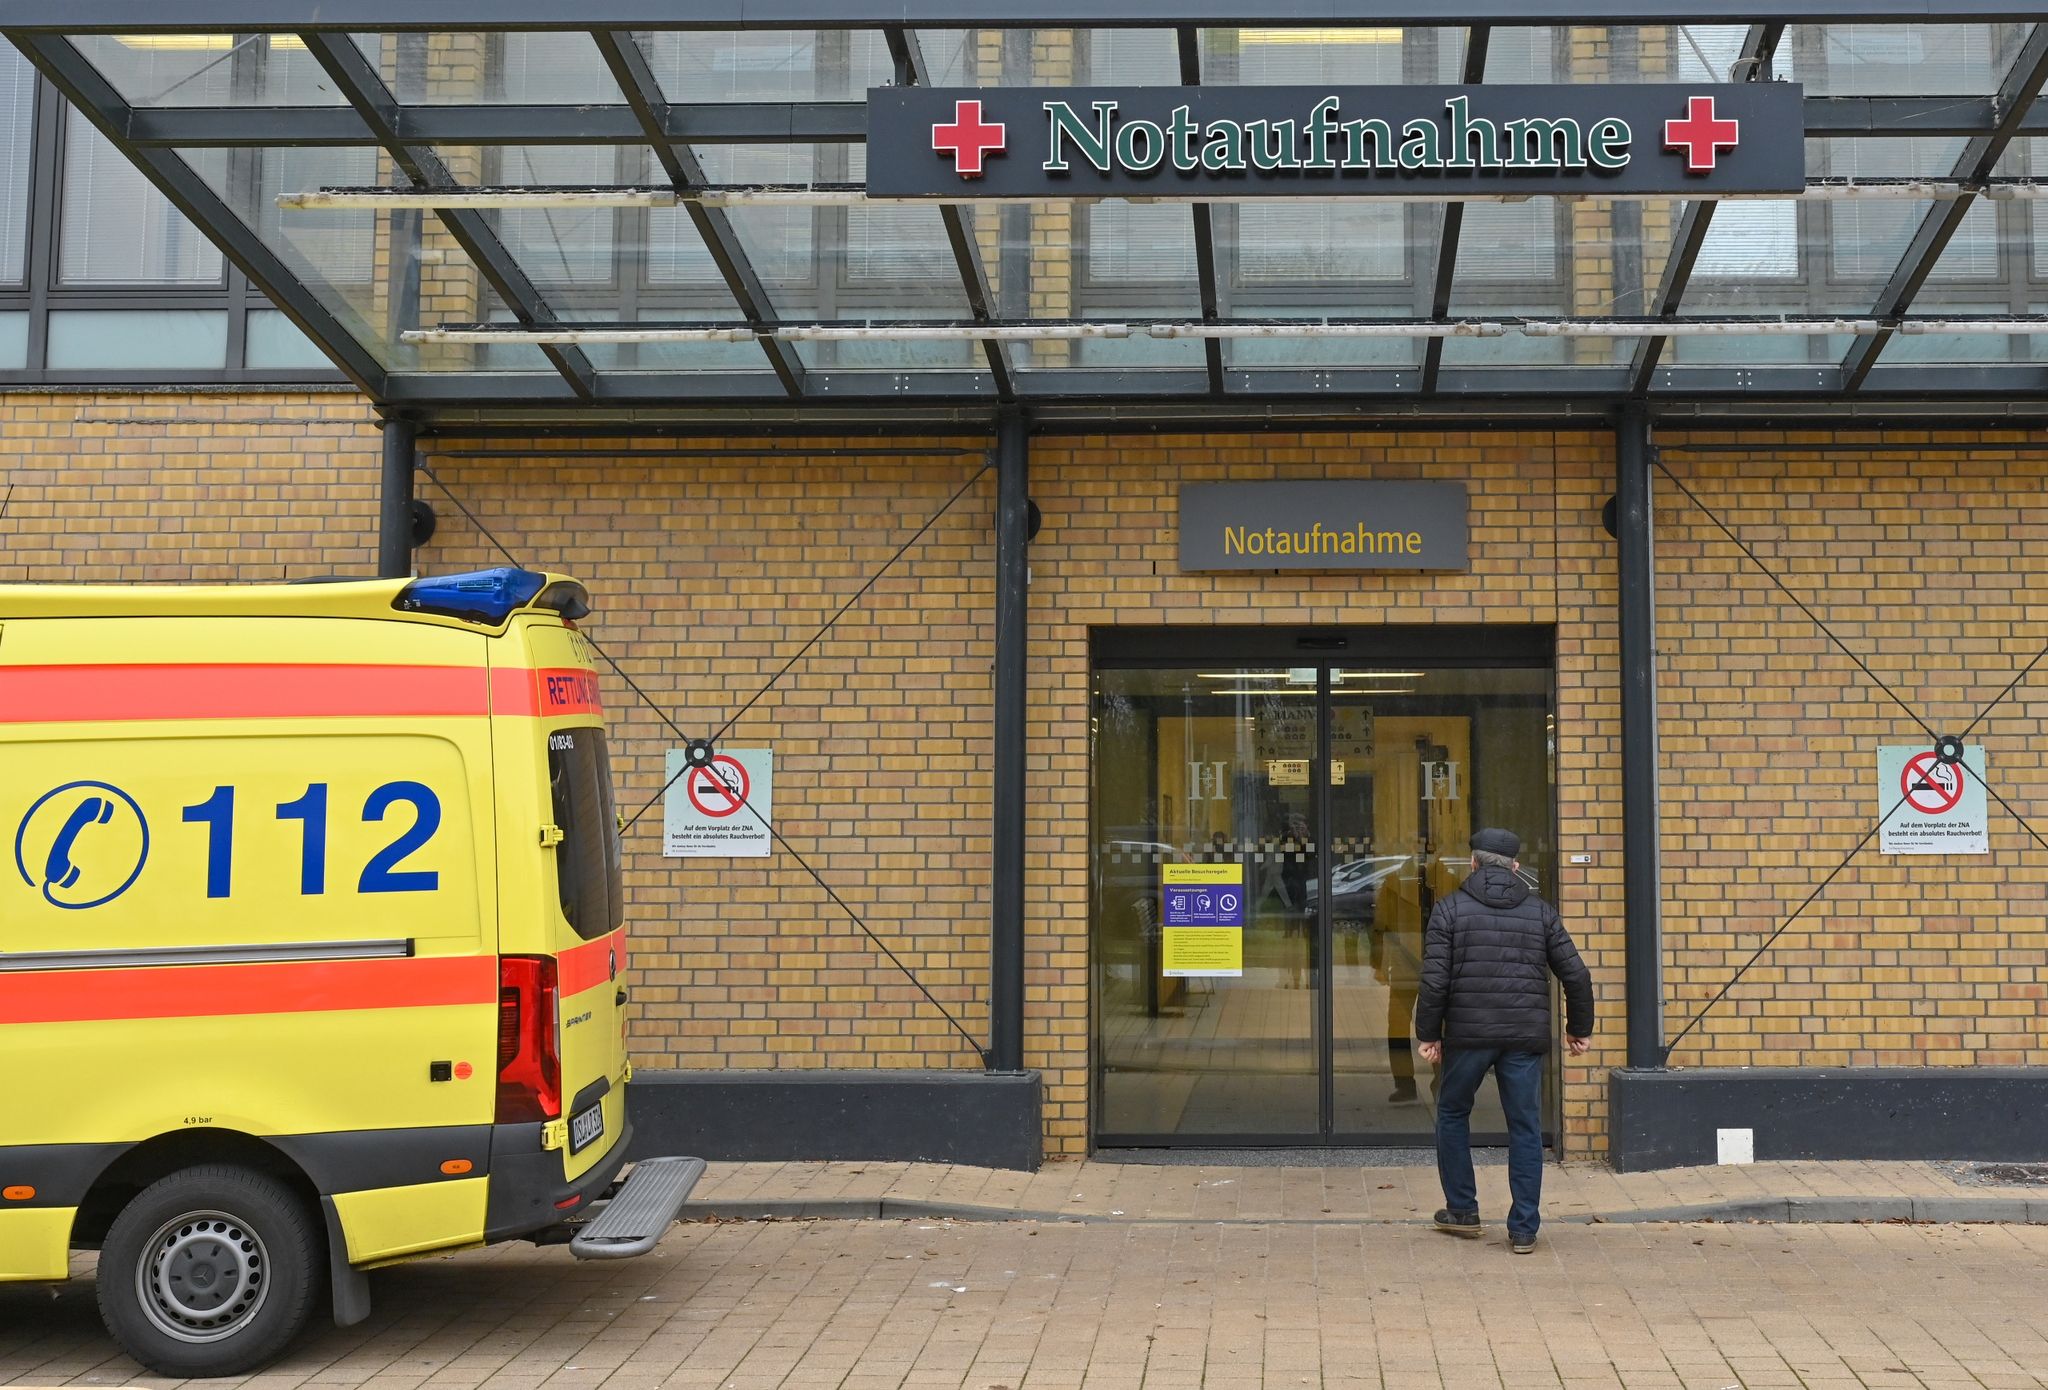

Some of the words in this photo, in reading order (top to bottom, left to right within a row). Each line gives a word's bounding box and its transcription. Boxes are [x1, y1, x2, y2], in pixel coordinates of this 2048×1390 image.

[1042, 95, 1632, 172] Notaufnahme
[1224, 522, 1422, 555] Notaufnahme
[182, 781, 441, 898] 112
[565, 1010, 592, 1029] SPRINTER
[183, 1116, 197, 1125] 4,9
[198, 1116, 213, 1124] bar
